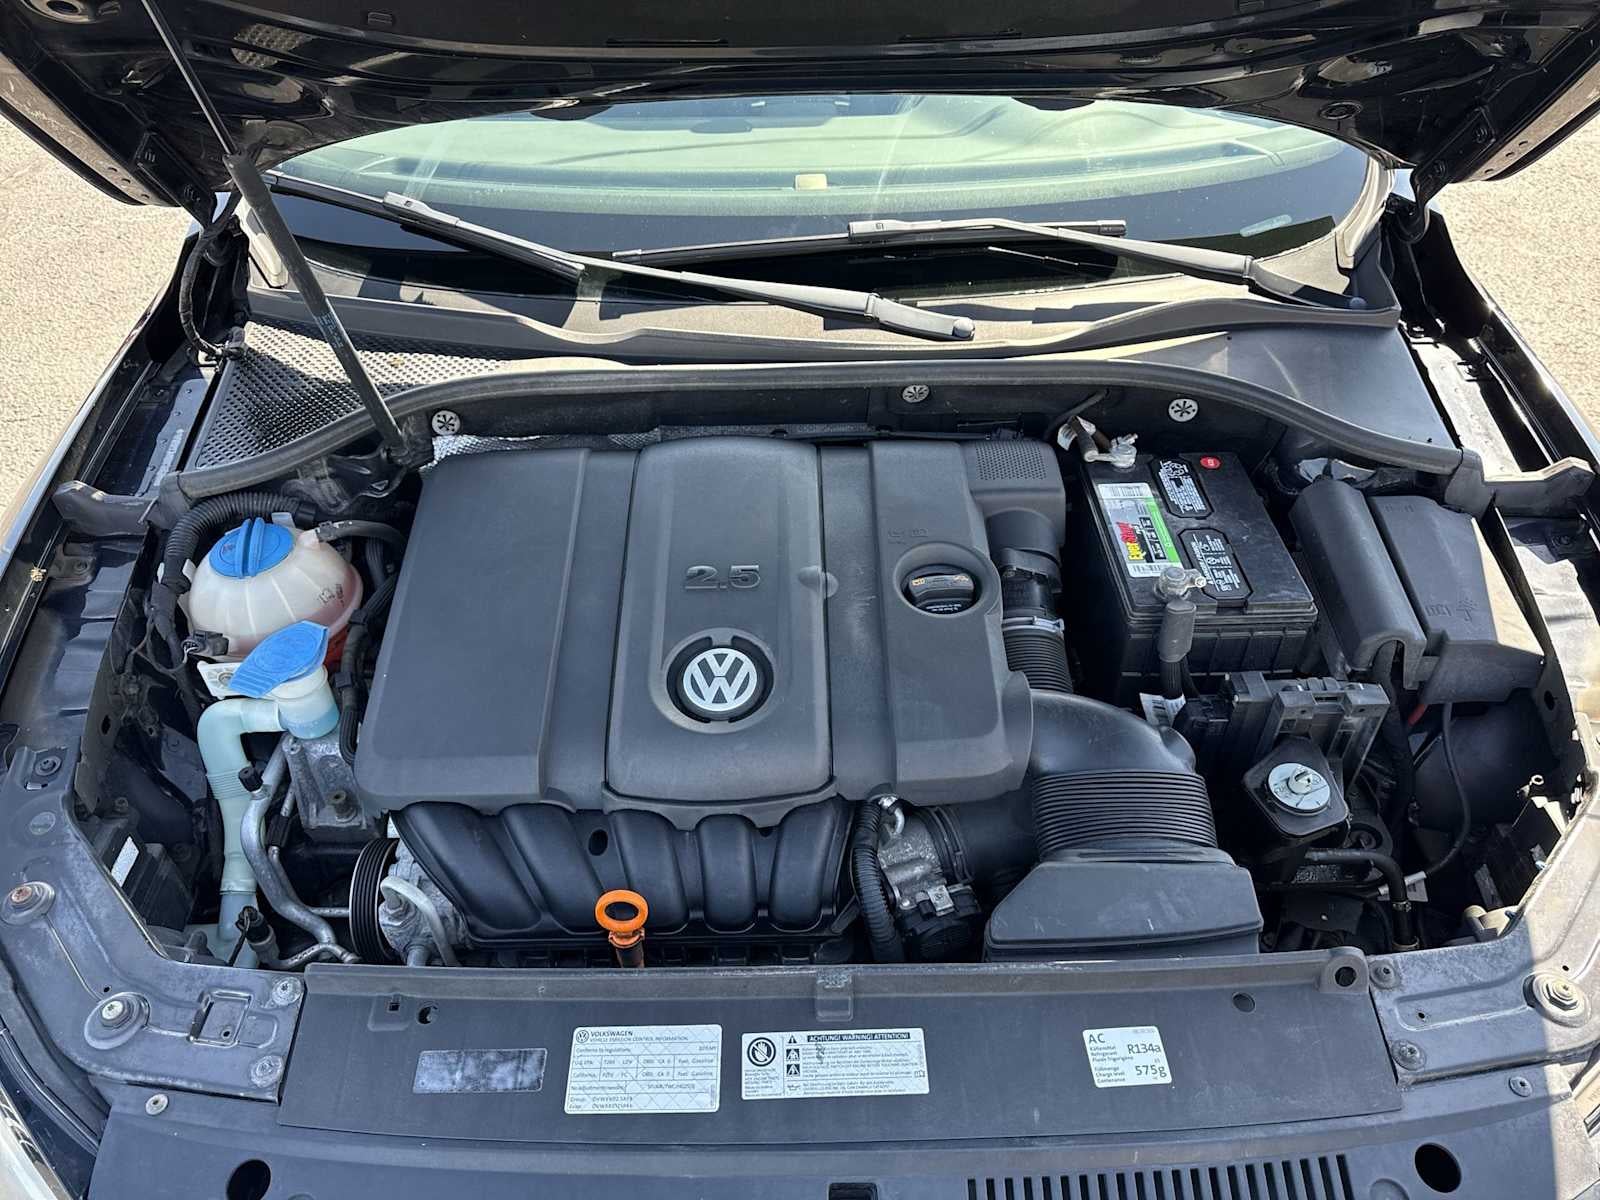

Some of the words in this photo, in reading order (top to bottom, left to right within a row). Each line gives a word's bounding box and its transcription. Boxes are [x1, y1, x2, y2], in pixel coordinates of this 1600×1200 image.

[685, 564, 761, 590] 2.5
[1088, 1033, 1106, 1044] AC
[1127, 1043, 1161, 1054] R134a
[1135, 1065, 1168, 1078] 575g
